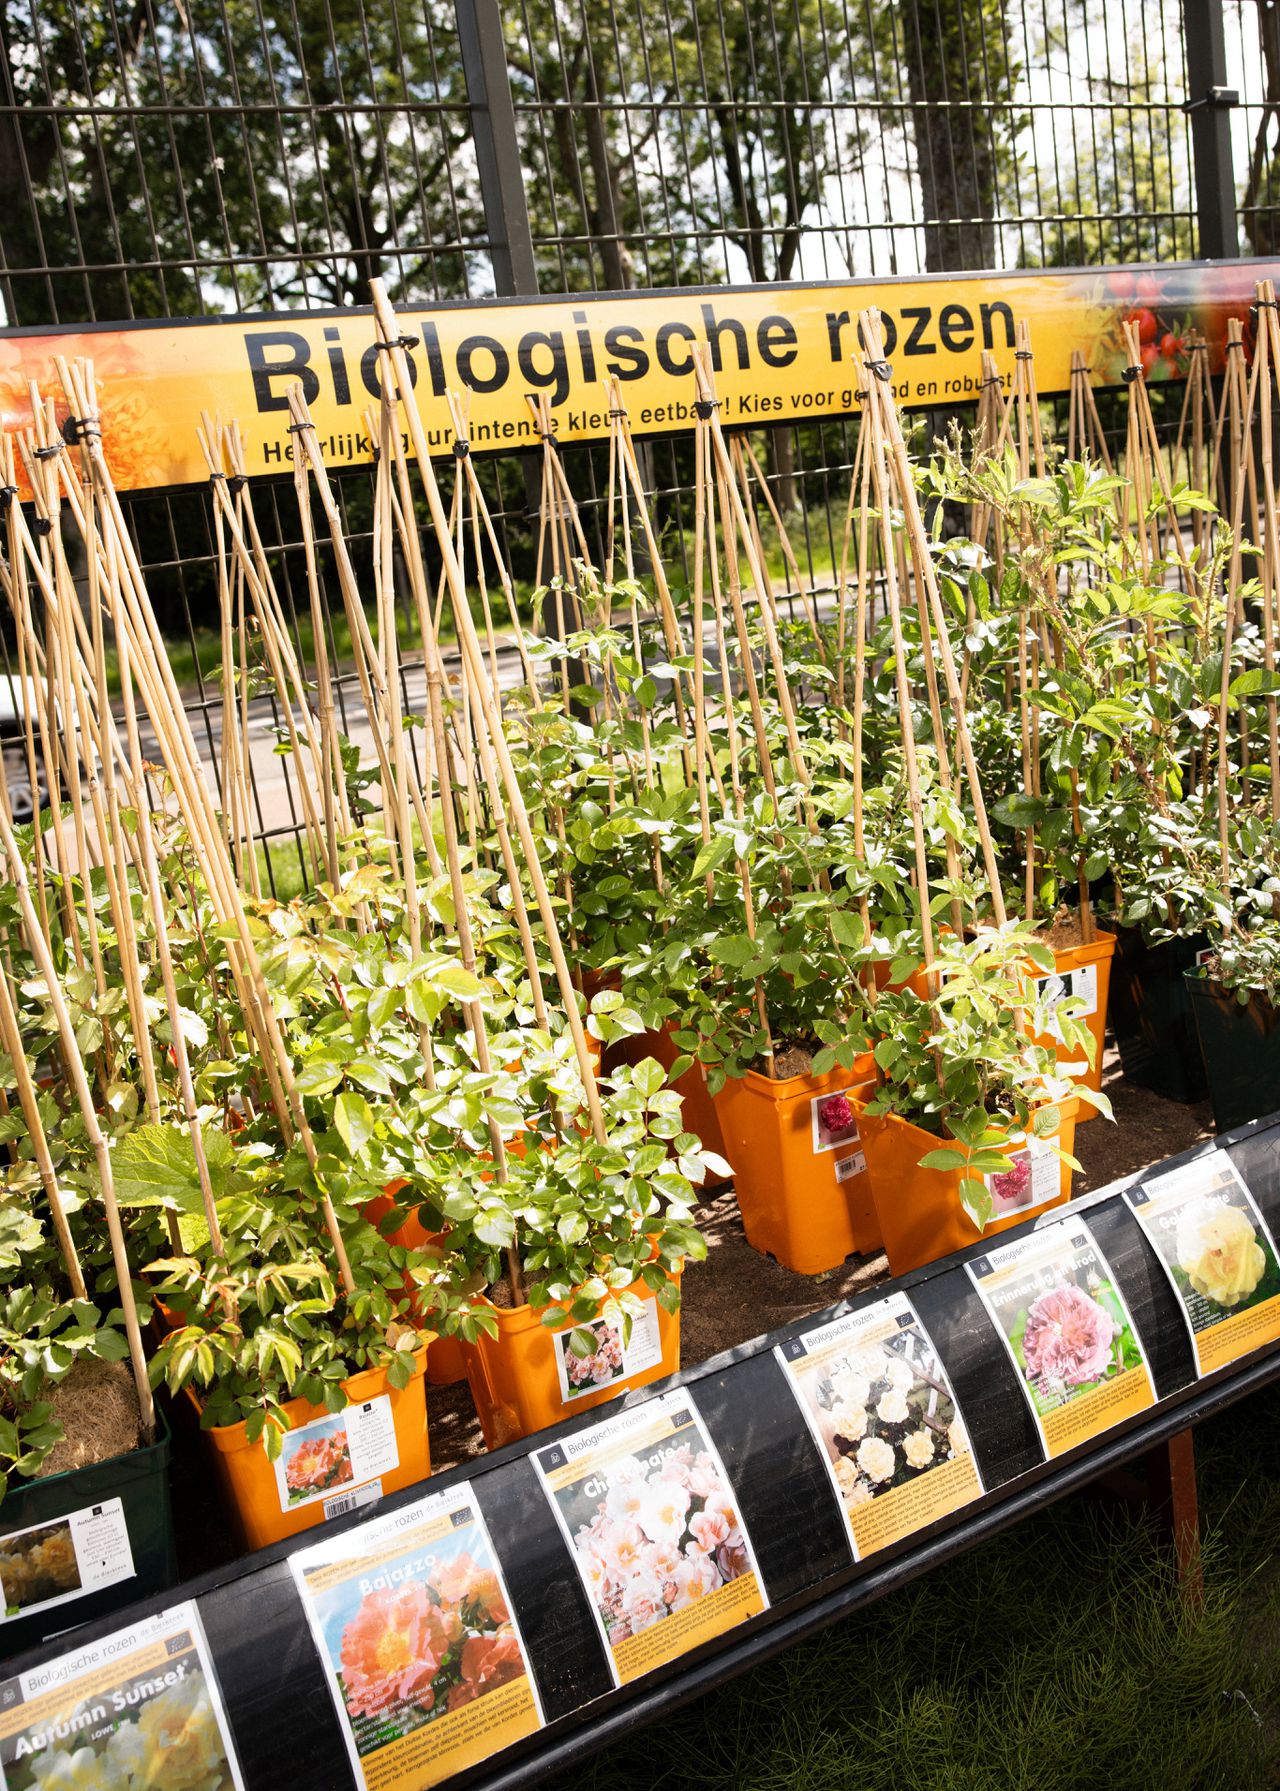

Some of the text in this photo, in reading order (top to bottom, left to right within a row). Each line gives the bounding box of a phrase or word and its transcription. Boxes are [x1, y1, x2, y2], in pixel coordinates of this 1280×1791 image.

[244, 300, 1015, 412] Biologische rozen
[739, 393, 784, 414] Kies
[791, 391, 835, 408] voor
[916, 381, 937, 396] en
[806, 1323, 852, 1349] Biologische
[852, 1311, 875, 1330] rozen
[395, 1508, 424, 1528] rozen
[360, 1553, 436, 1596] Bajazzo
[28, 1650, 100, 1692] Biologische
[102, 1634, 137, 1657] rozen
[15, 1705, 107, 1760] Autumn
